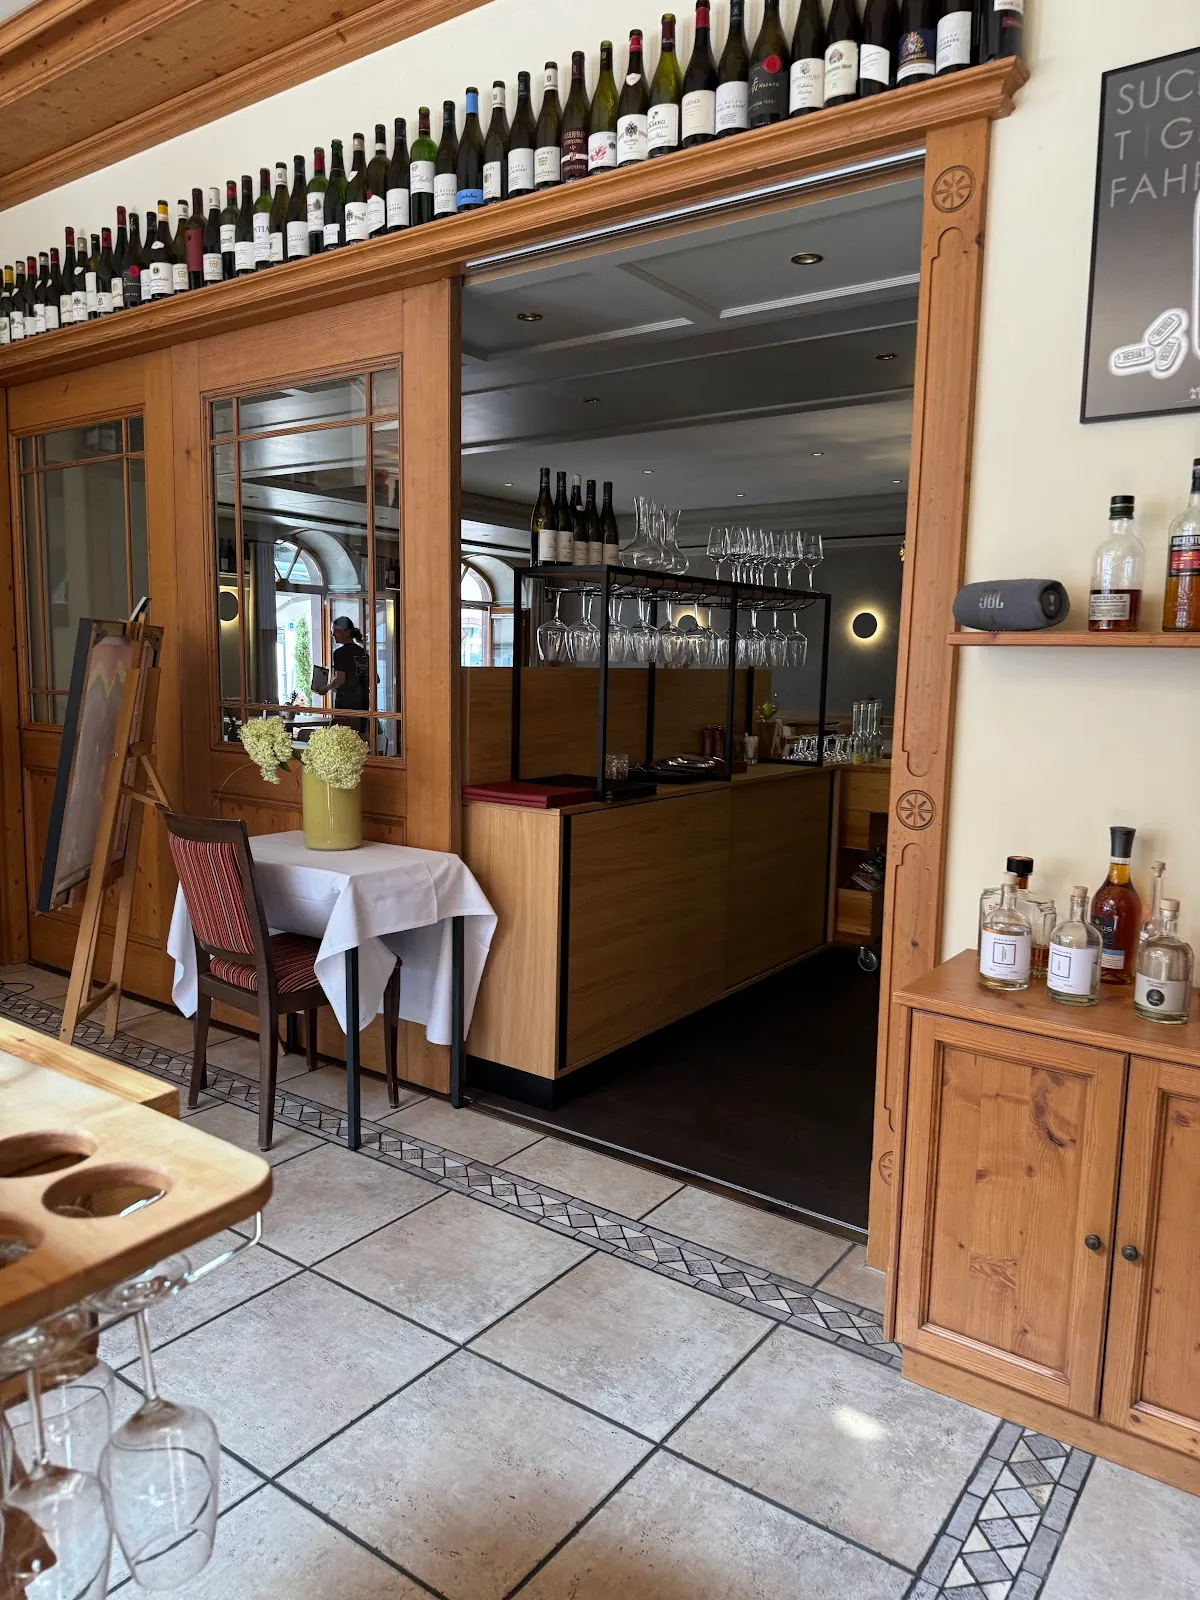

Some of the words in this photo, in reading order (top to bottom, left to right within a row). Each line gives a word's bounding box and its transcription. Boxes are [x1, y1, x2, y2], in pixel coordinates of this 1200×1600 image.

[1117, 68, 1200, 115] SUC
[1161, 117, 1200, 149] G
[979, 591, 1005, 609] JBL
